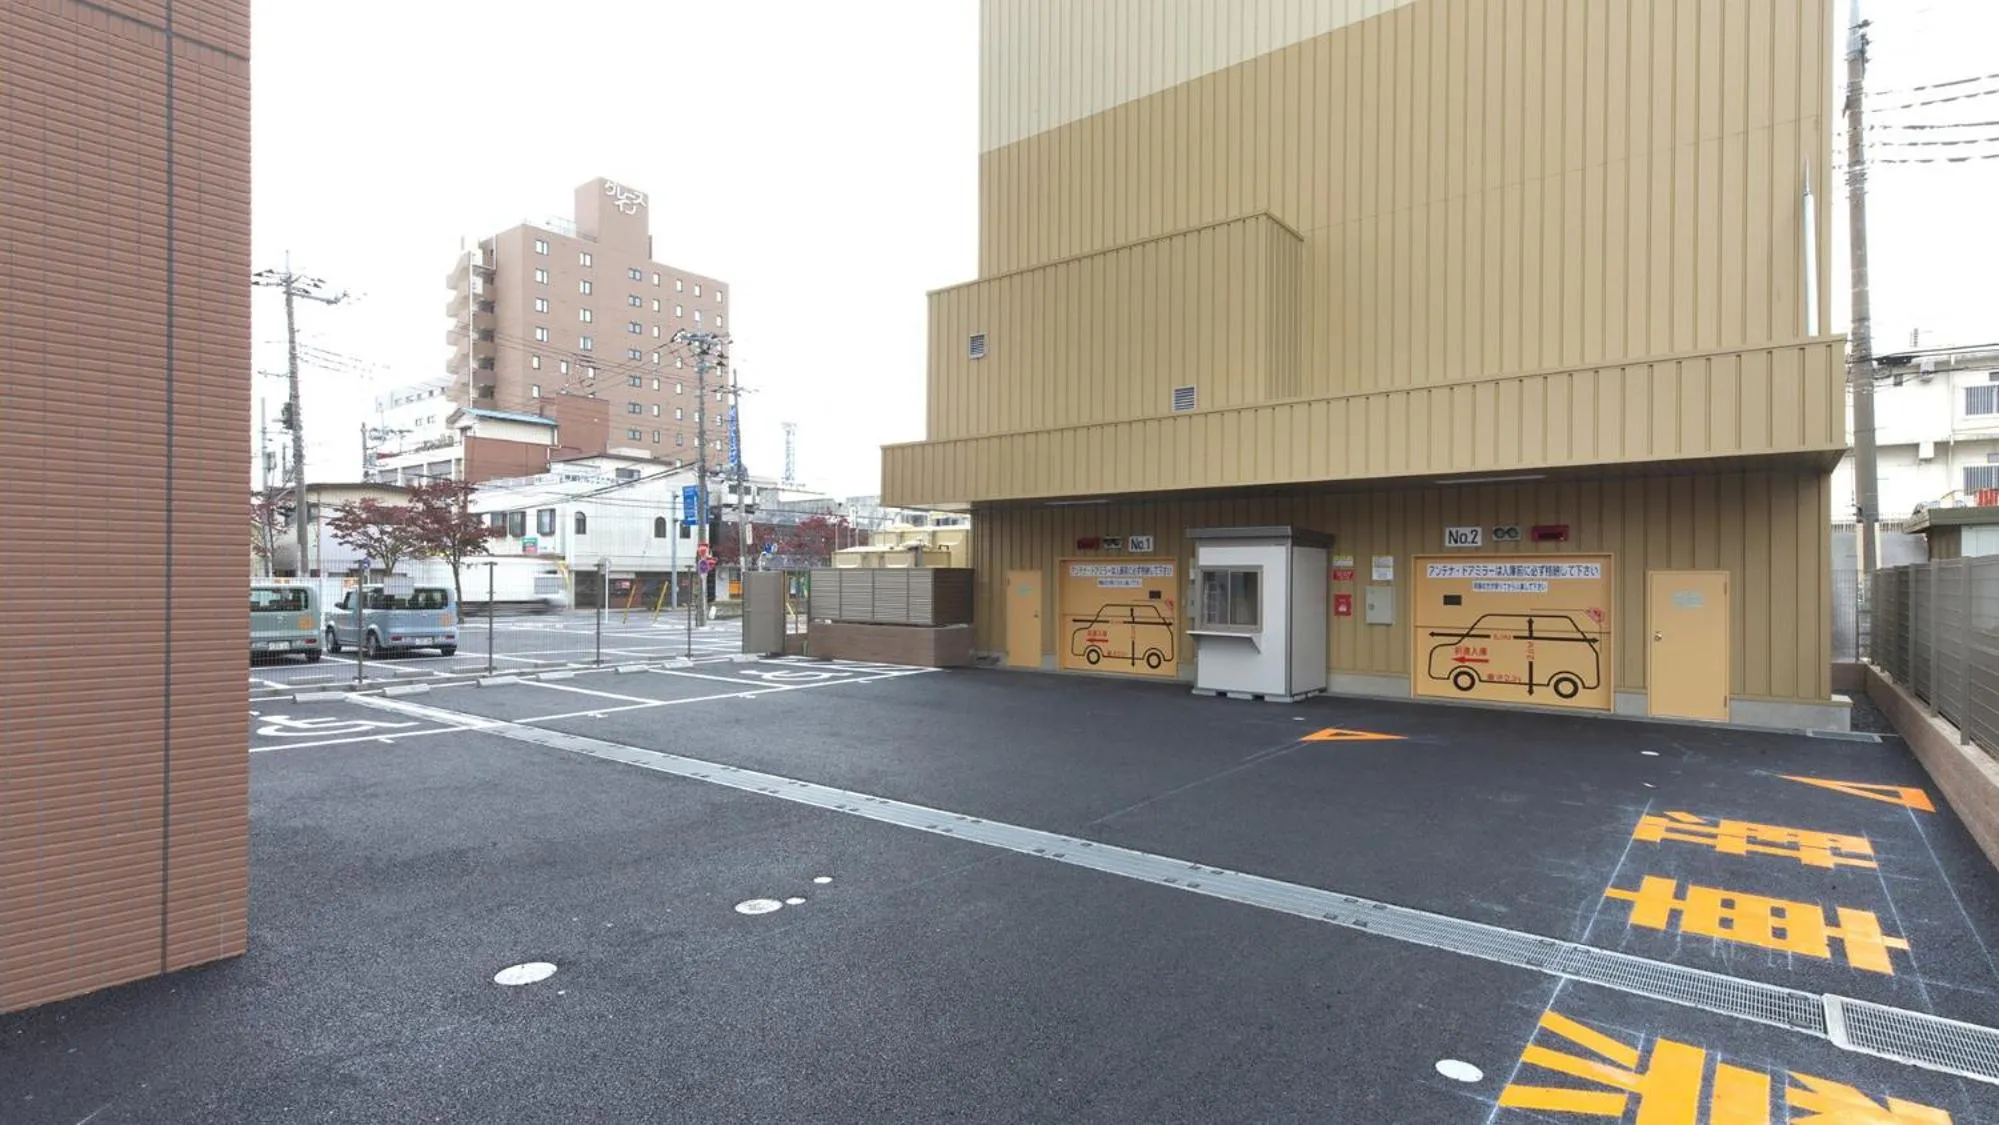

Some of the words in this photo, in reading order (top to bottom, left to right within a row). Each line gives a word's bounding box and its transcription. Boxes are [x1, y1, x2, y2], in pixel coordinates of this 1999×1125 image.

[613, 199, 637, 216] イン
[1130, 537, 1151, 550] No.1
[1447, 528, 1480, 546] No.2
